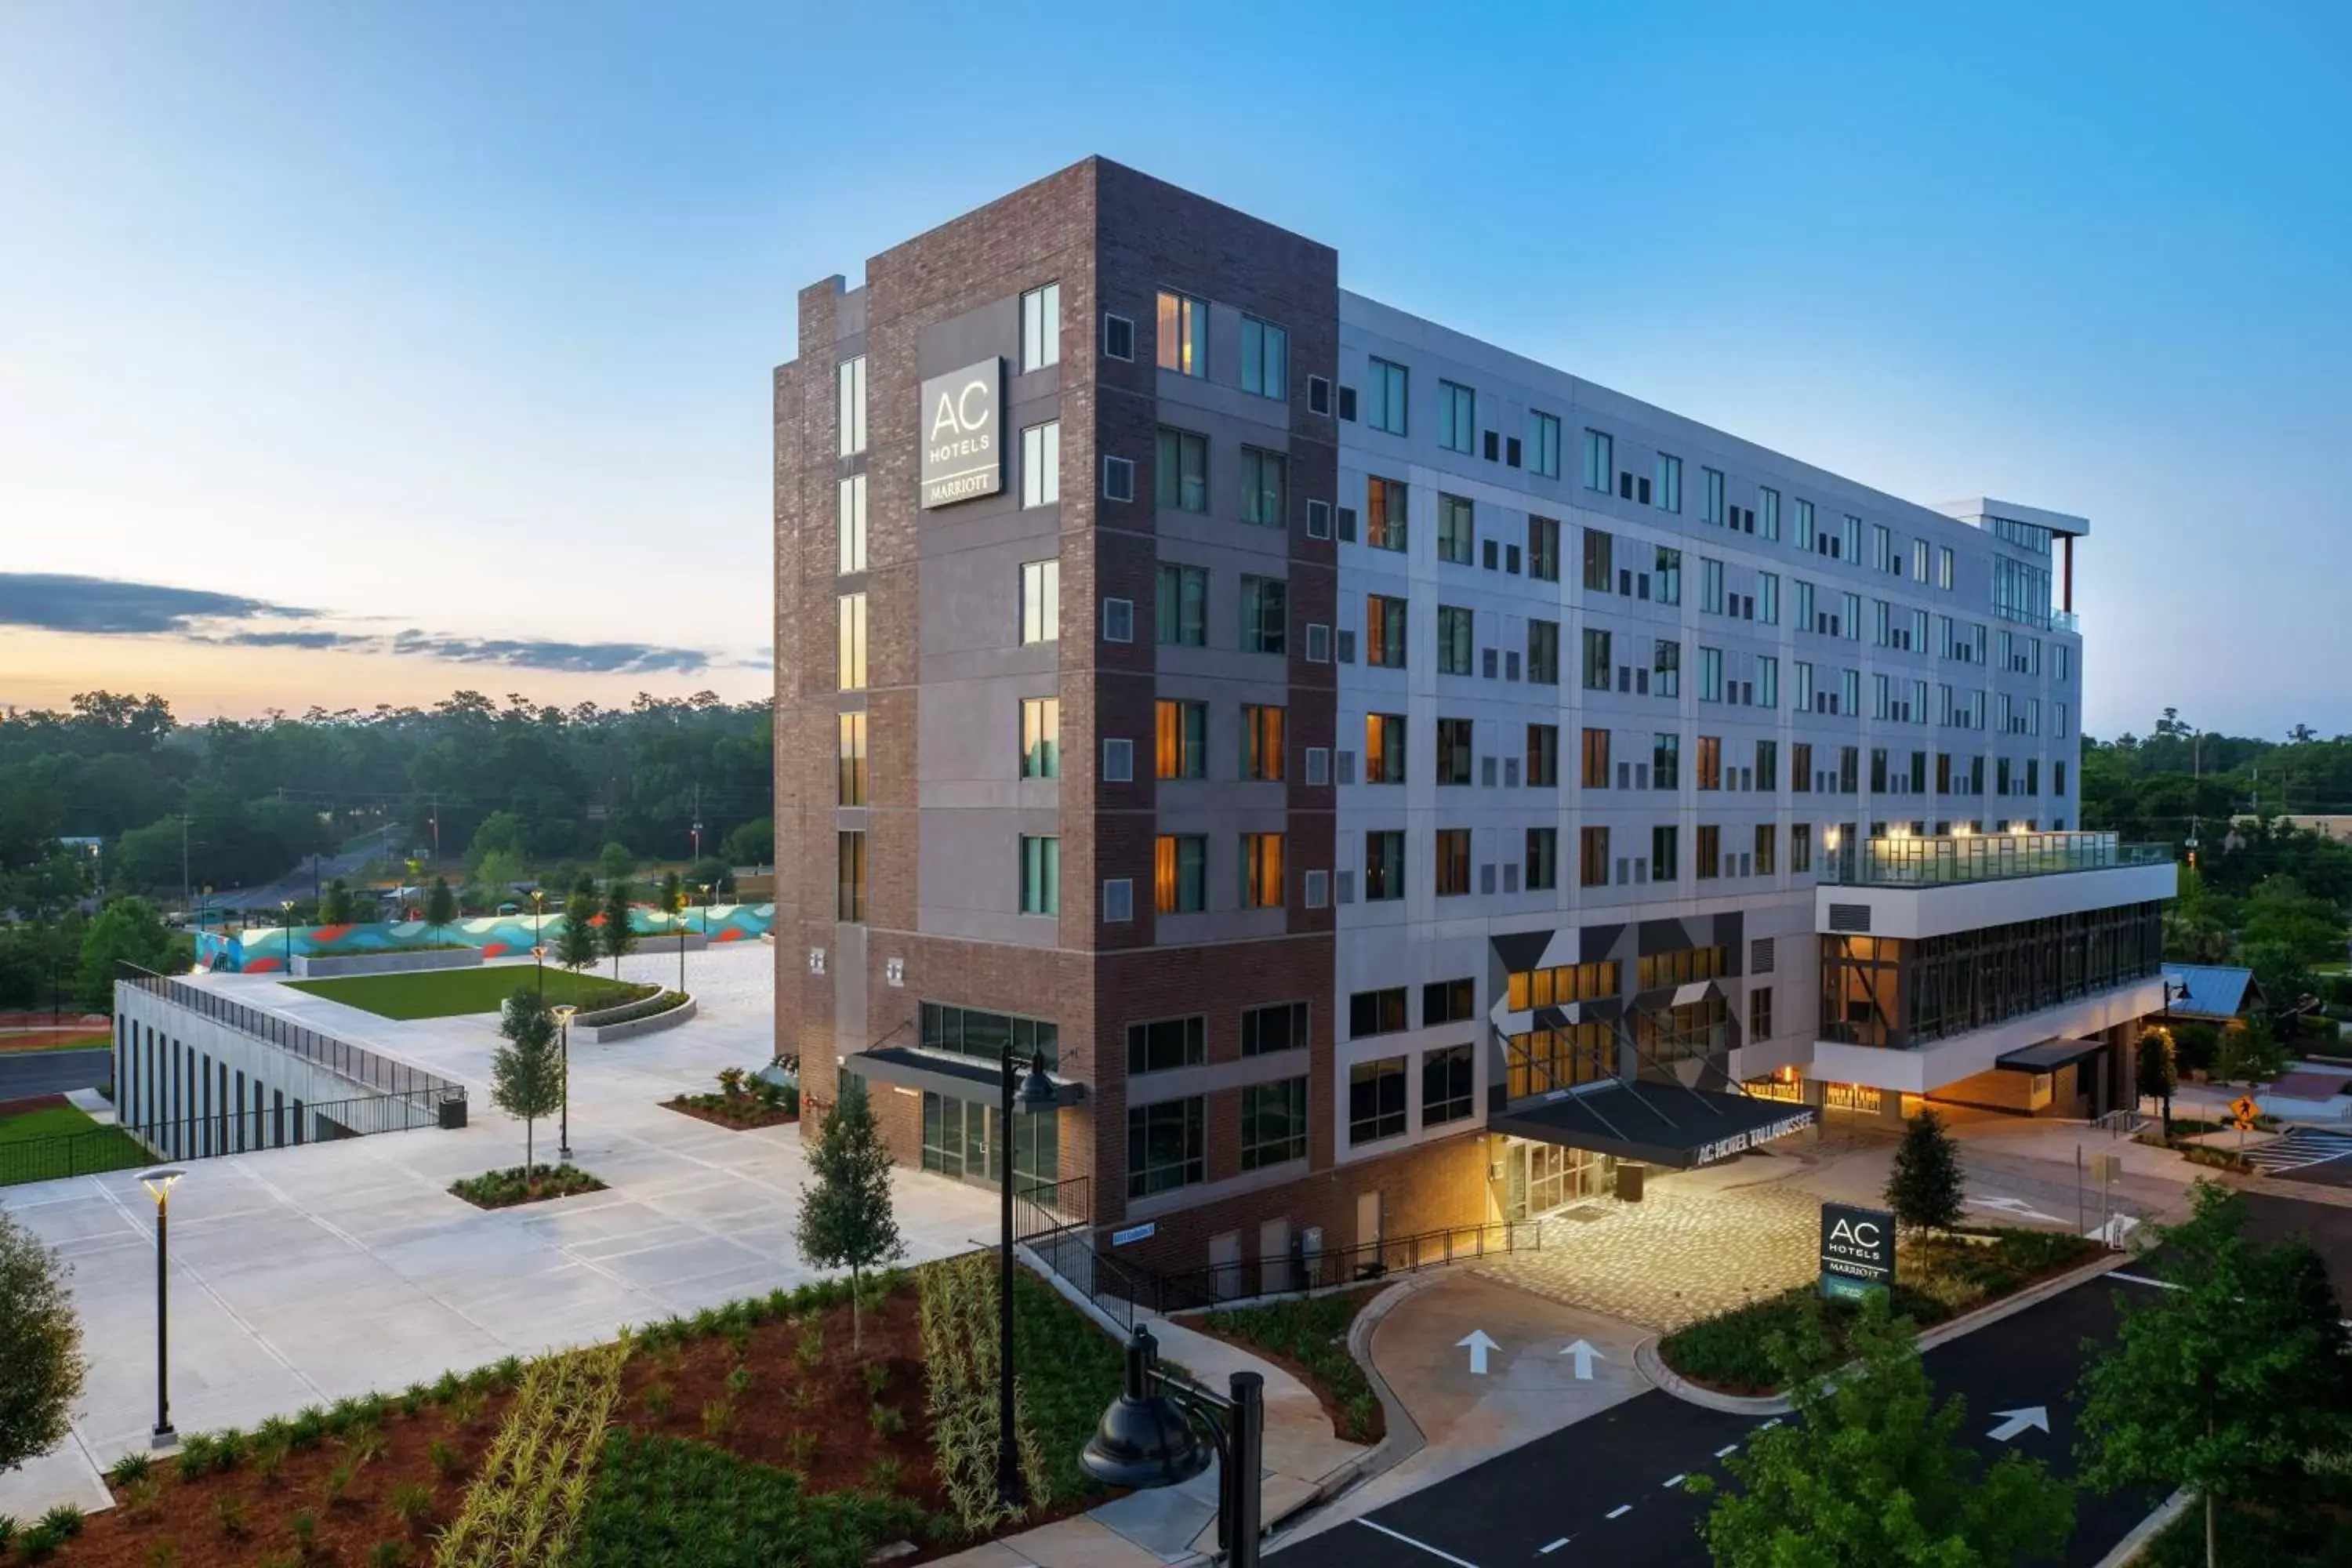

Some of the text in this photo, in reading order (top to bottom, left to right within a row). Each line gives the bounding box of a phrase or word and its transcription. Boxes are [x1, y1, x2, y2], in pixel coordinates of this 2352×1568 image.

[931, 379, 989, 442] AC
[930, 434, 989, 464] HOTELS
[931, 474, 989, 501] MARRIOTT
[1697, 1144, 1715, 1166] AC
[1715, 1133, 1749, 1160] HOTEL
[1830, 1218, 1880, 1248] AC
[1829, 1243, 1880, 1260] HOTELS
